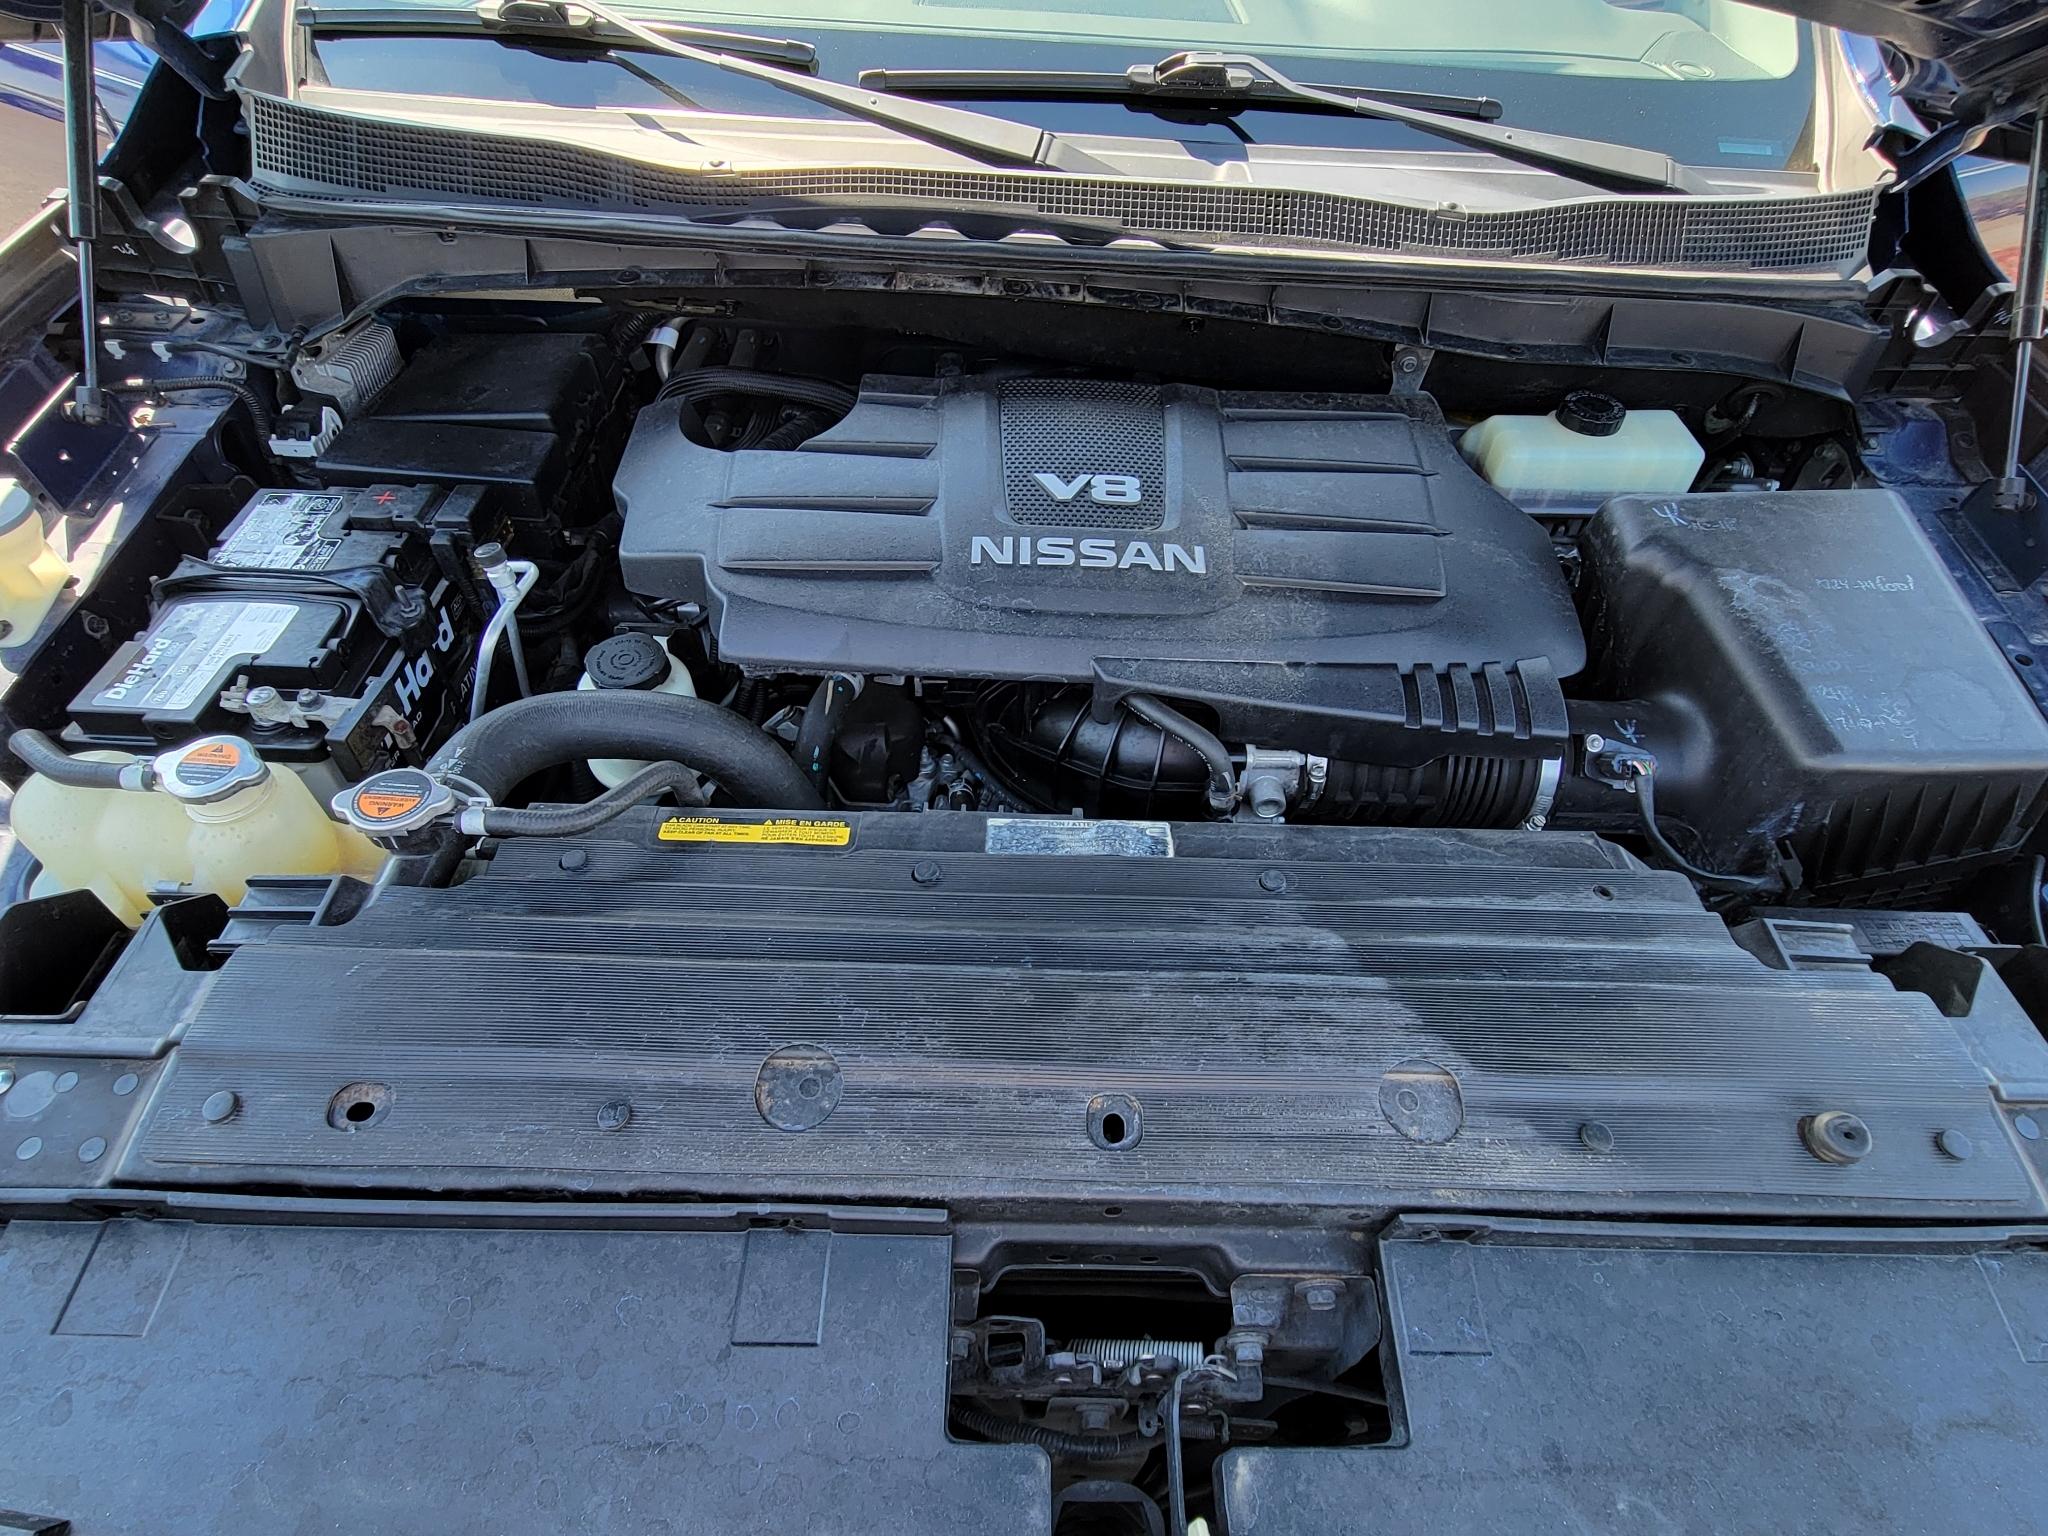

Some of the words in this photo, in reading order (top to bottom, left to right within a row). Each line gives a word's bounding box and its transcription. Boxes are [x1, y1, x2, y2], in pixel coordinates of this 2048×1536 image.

[1033, 473, 1142, 506] V8
[971, 536, 1207, 574] NISSAN
[104, 637, 173, 701] DieHard
[368, 800, 404, 809] WARNING
